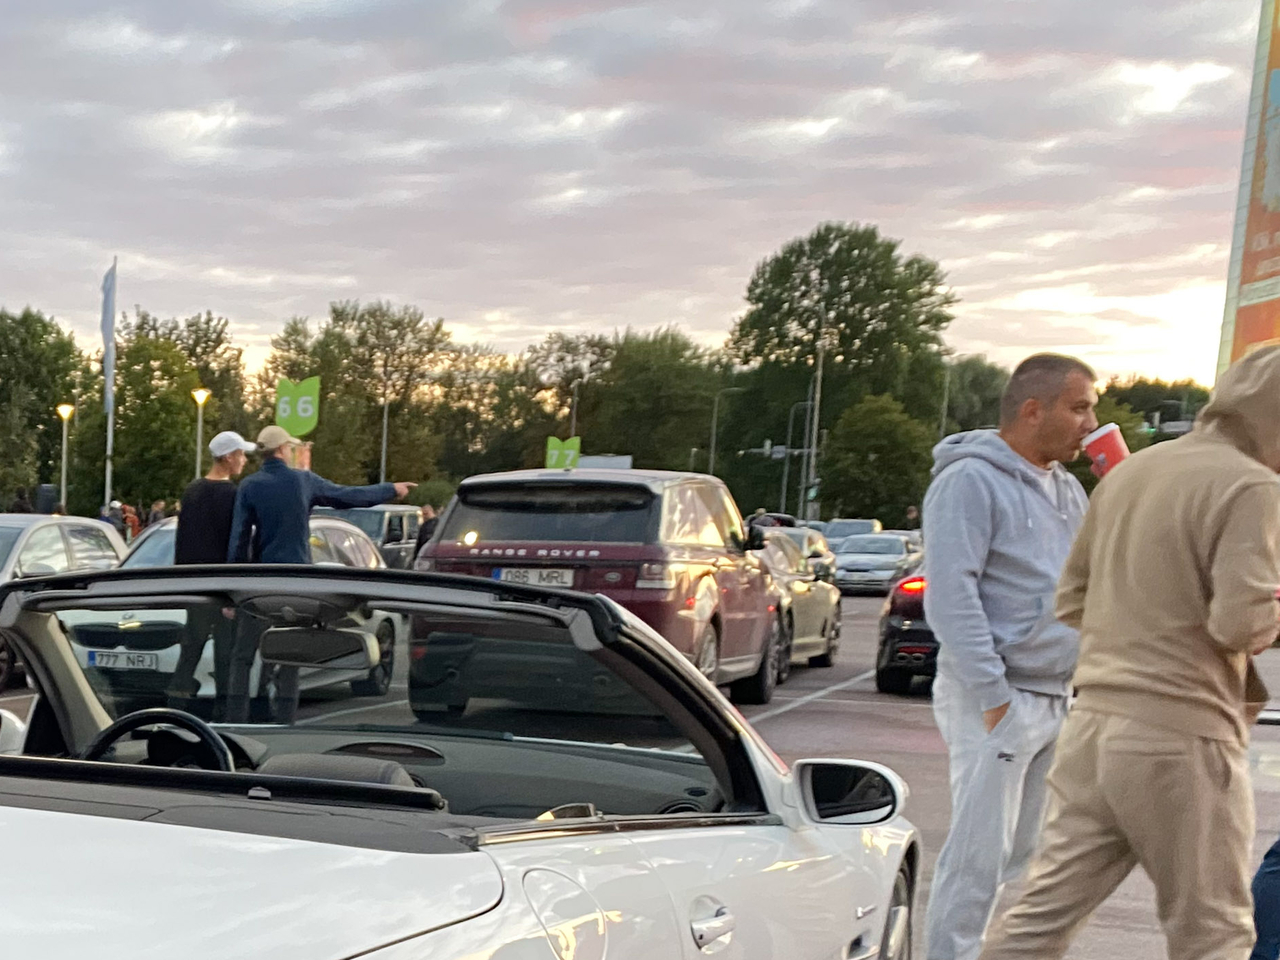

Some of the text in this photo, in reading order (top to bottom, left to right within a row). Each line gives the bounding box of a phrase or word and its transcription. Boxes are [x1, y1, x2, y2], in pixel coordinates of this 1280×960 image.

[279, 396, 291, 418] 6
[297, 396, 314, 417] 6
[564, 450, 575, 467] 7
[537, 549, 600, 557] ROVER
[538, 570, 568, 584] MRL
[98, 653, 153, 667] 777 NRJ
